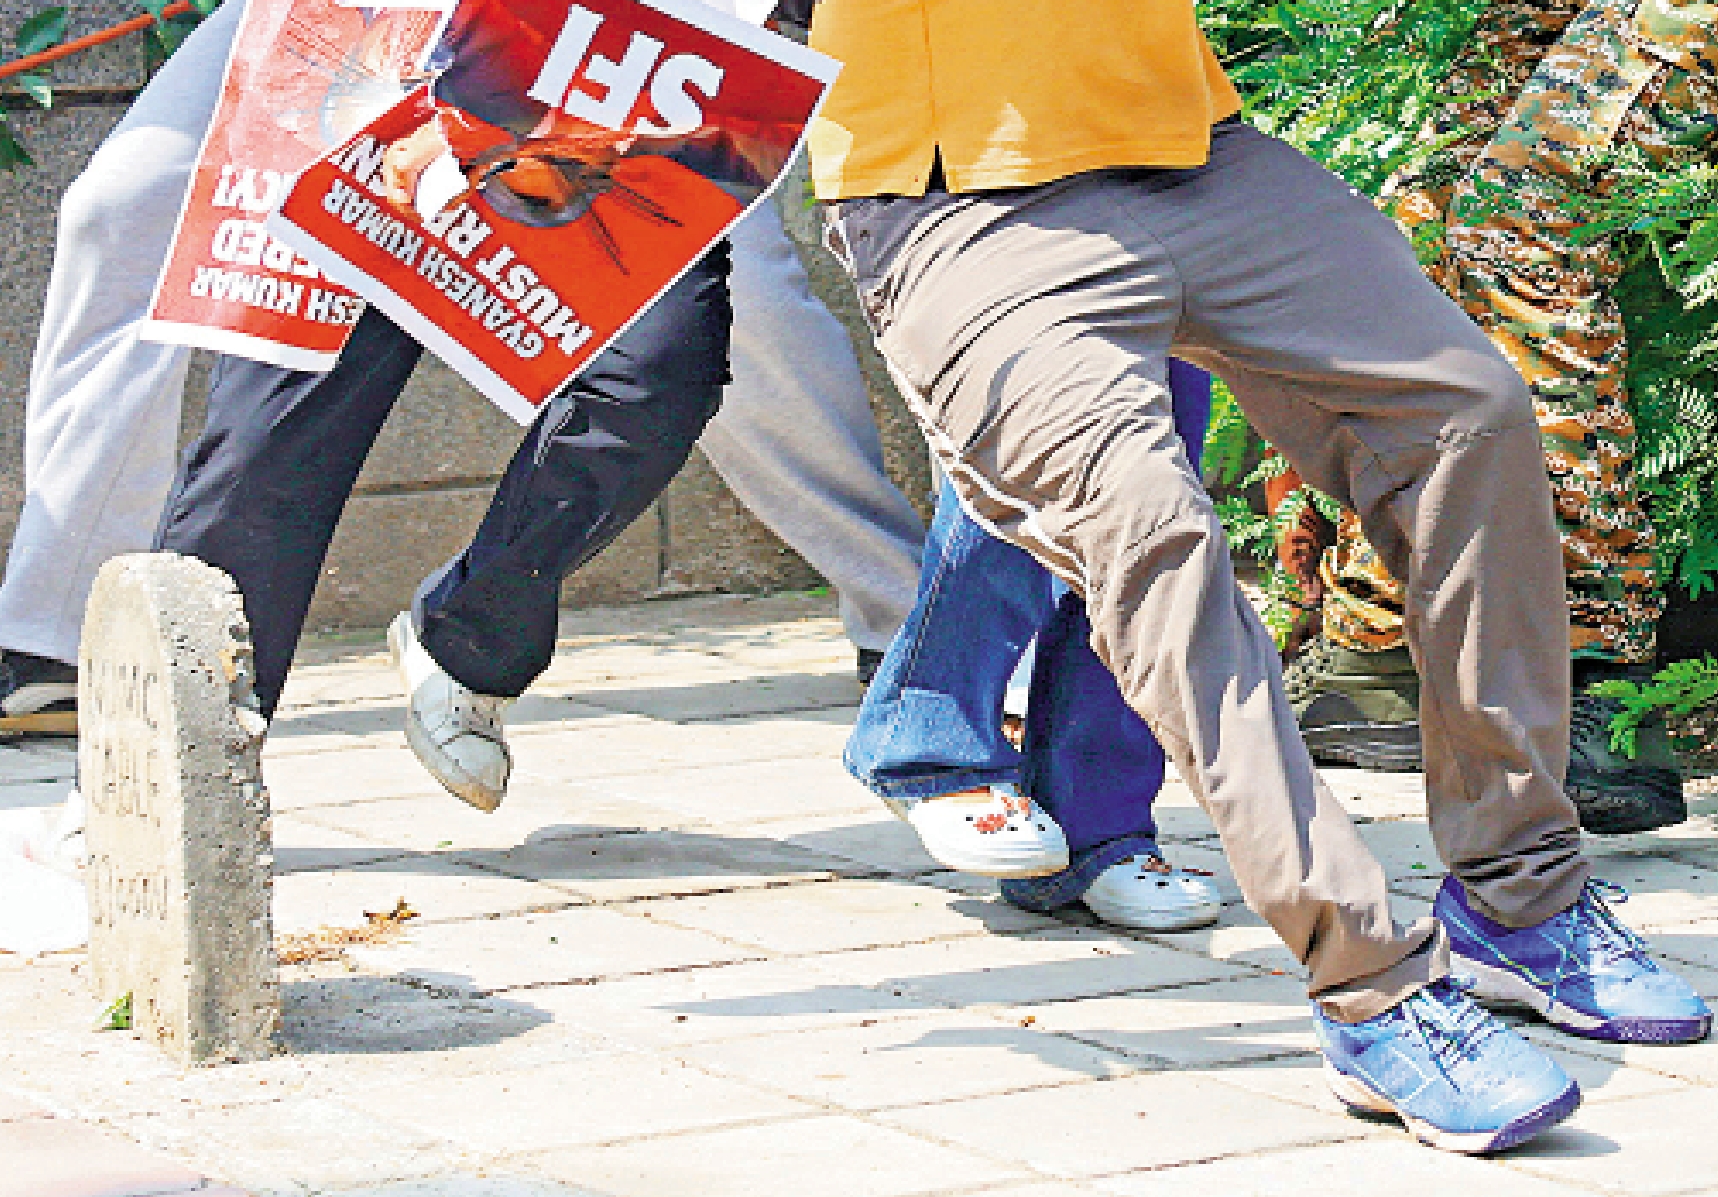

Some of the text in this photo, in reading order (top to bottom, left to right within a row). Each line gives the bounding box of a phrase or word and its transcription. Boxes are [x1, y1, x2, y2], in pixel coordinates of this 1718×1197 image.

[526, 3, 726, 137] SFI
[189, 267, 305, 314] KUMAR
[321, 177, 545, 360] GYANESH KUMAR
[475, 244, 594, 356] MUST
